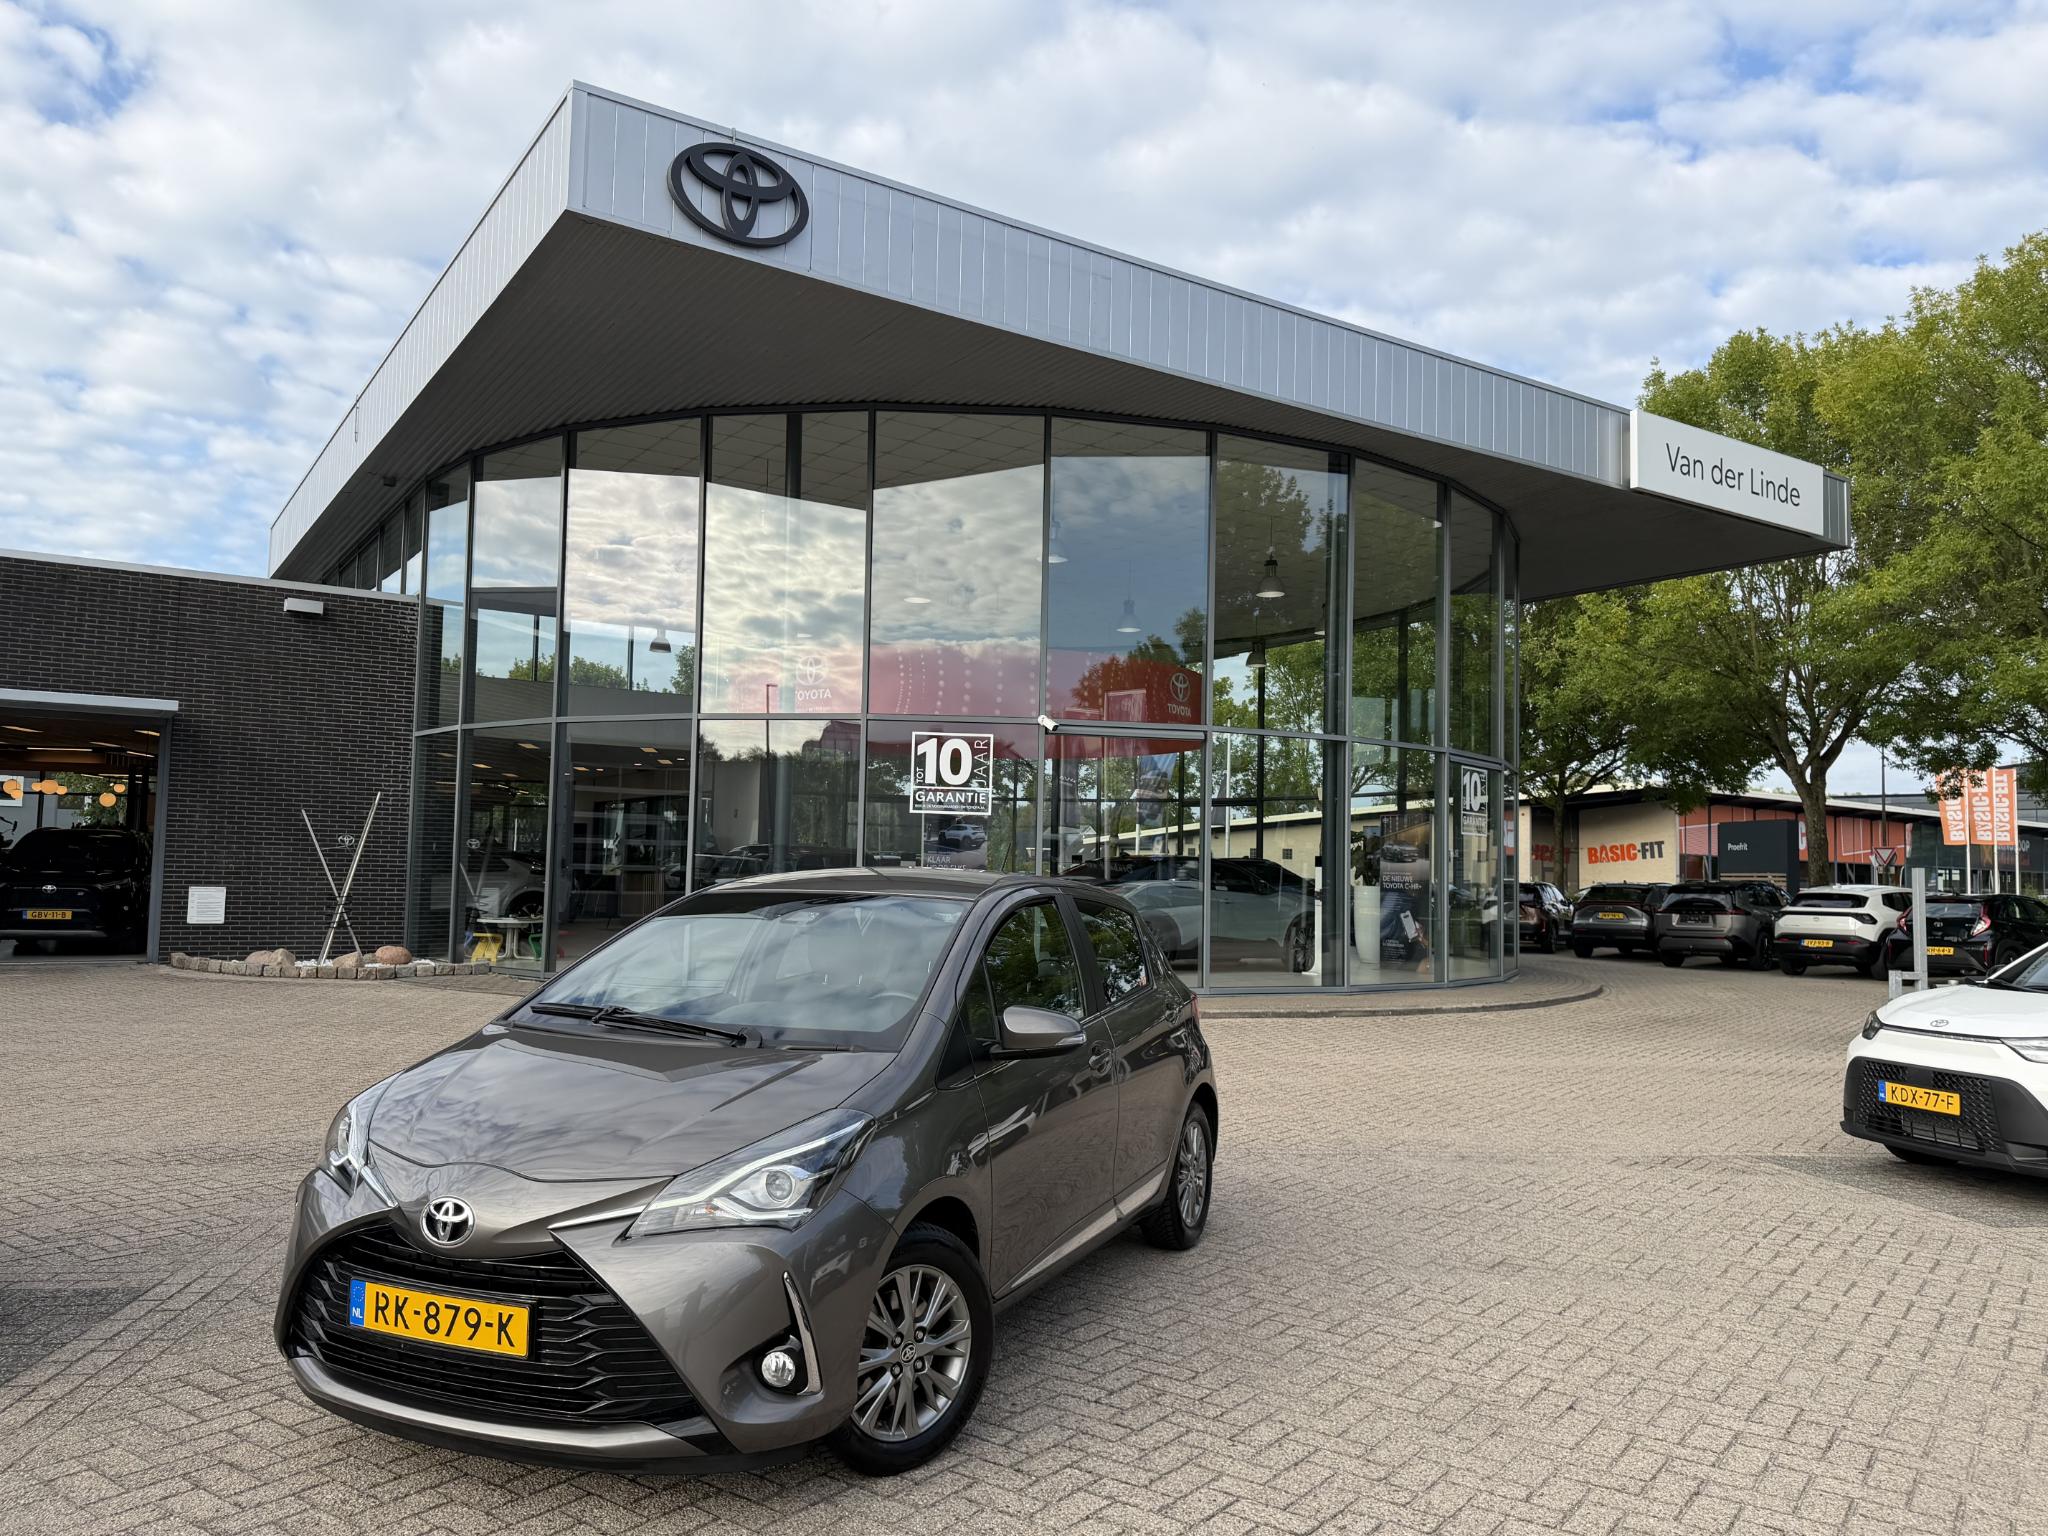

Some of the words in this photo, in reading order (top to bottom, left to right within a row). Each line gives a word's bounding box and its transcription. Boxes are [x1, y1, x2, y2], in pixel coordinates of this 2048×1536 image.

[1665, 442, 1704, 481] Van
[1711, 457, 1744, 491] der
[1750, 467, 1801, 507] Linde
[1168, 703, 1191, 718] TOYOTA
[917, 737, 972, 786] 10
[974, 739, 988, 787] JAAR
[916, 767, 924, 783] TOT
[915, 790, 987, 804] GARANTIE
[1463, 770, 1481, 812] 10
[1587, 841, 1664, 865] BASIC-FIT
[1727, 842, 1748, 851] Proefrit
[927, 855, 951, 864] KLAAR
[1391, 875, 1413, 883] NIEUWE
[1891, 1086, 1954, 1110] KDX-77-F
[352, 1307, 363, 1319] NL
[374, 1290, 515, 1348] RK-879-K
